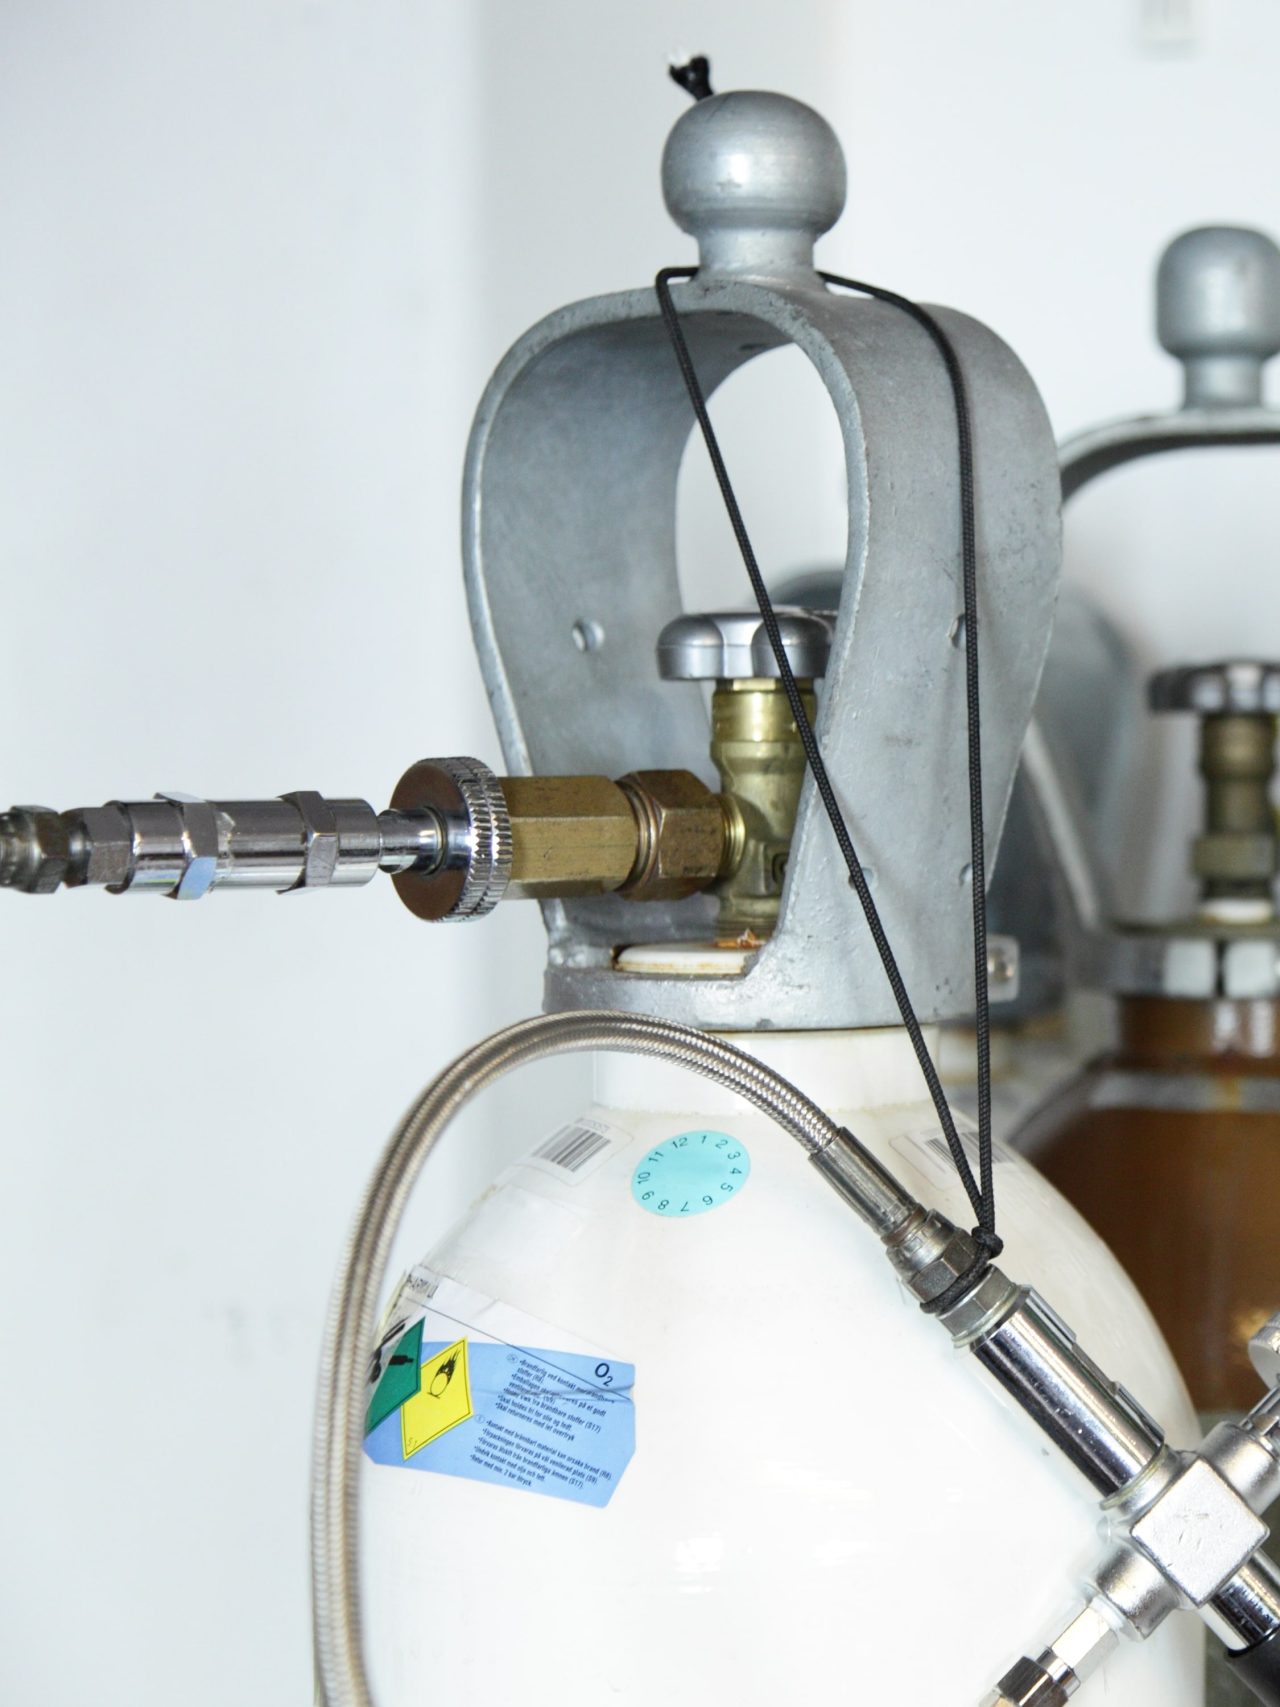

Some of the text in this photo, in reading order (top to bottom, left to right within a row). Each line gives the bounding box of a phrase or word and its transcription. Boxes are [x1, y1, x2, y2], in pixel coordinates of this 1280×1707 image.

[672, 1137, 688, 1148] 12
[700, 1135, 708, 1144] 1
[716, 1139, 728, 1150] 2
[648, 1151, 664, 1162] 11
[728, 1151, 740, 1160] 3
[730, 1167, 742, 1176] 4
[637, 1172, 650, 1184] 10
[720, 1182, 734, 1192] 5
[641, 1191, 654, 1200] 9
[658, 1200, 670, 1210] 8
[702, 1196, 714, 1206] 6
[681, 1201, 690, 1212] 7
